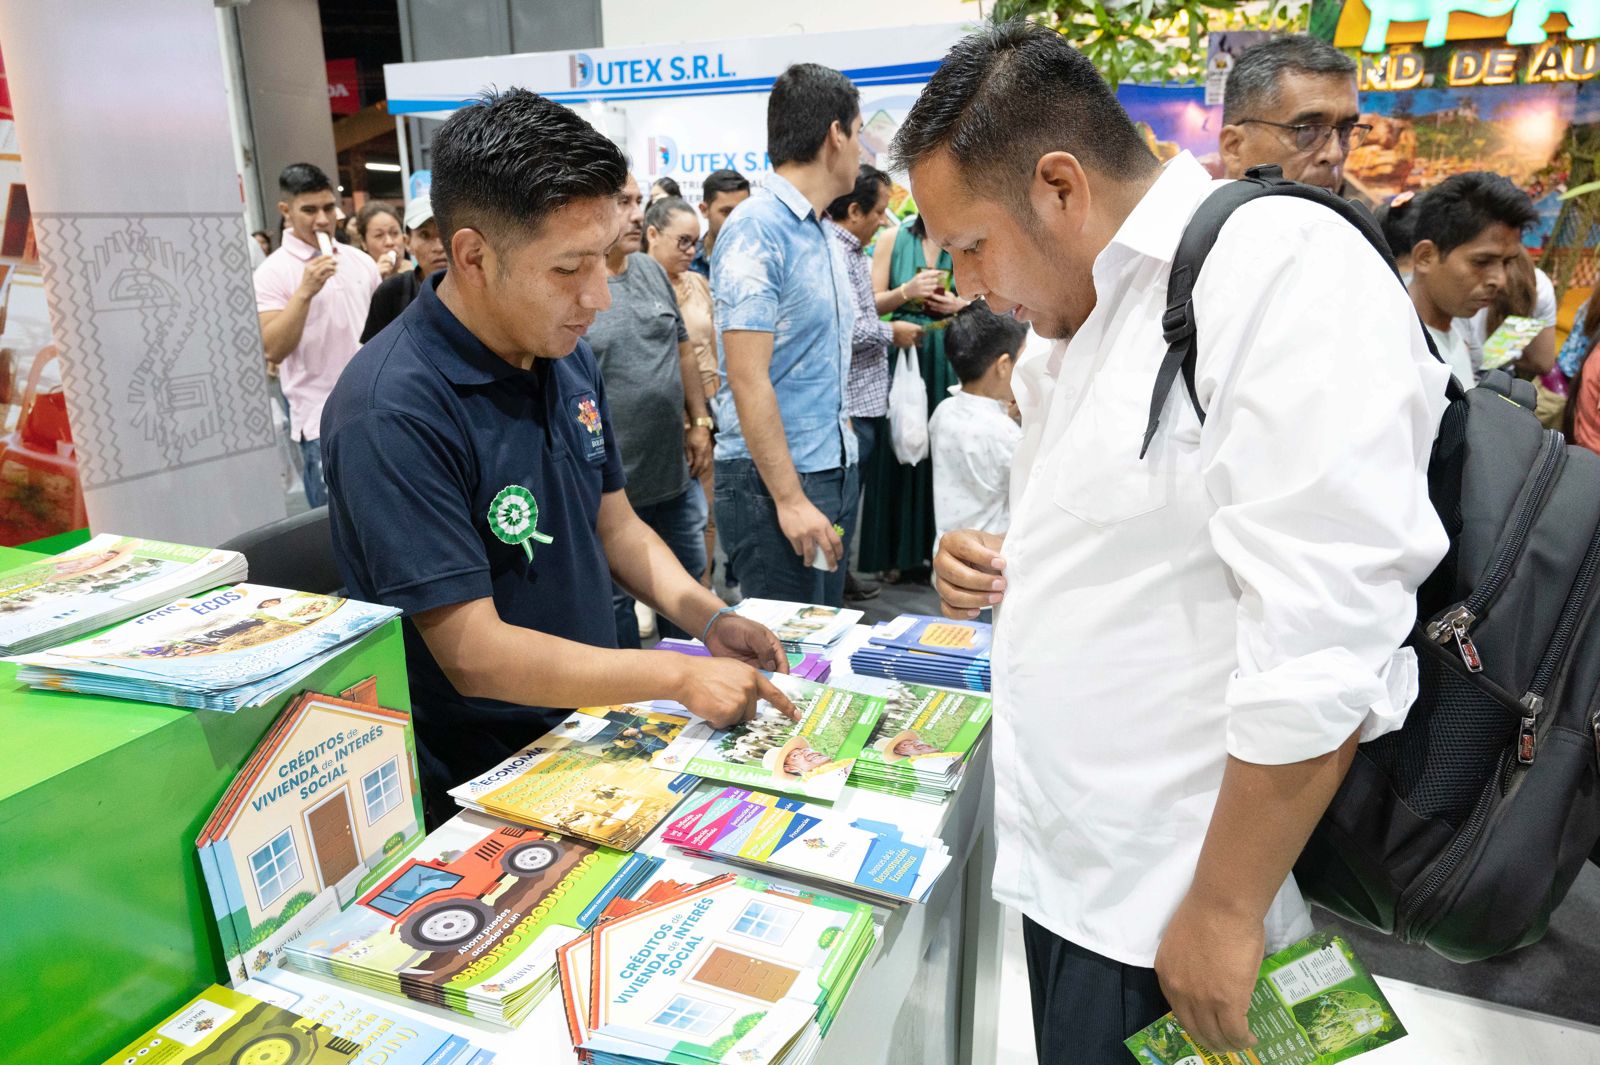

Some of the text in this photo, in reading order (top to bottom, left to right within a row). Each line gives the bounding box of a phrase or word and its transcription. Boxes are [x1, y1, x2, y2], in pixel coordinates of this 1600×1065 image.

[670, 53, 737, 81] S.R.L.
[1359, 44, 1600, 90] ND. DE AU
[190, 591, 243, 616] ECOS
[251, 725, 383, 813] VIVIENDA de INTERÉS
[278, 727, 358, 779] CRÉDITOS de
[480, 746, 548, 787] ECONOMÍA
[687, 762, 725, 777] CRUZ
[299, 764, 348, 800] SOCIAL
[690, 828, 709, 846] Inflación
[789, 817, 811, 839] Presentación
[451, 853, 600, 982] CRÉDITO PRODUCTIVO
[458, 908, 511, 955] Ahora puedes
[471, 928, 504, 957] acceder
[508, 912, 521, 924] un
[613, 897, 714, 1004] VIVIENDA de INTERÉS
[619, 913, 683, 979] CRÉDITOS de
[662, 935, 704, 976] SOCIAL
[505, 963, 536, 985] BOLIVIA
